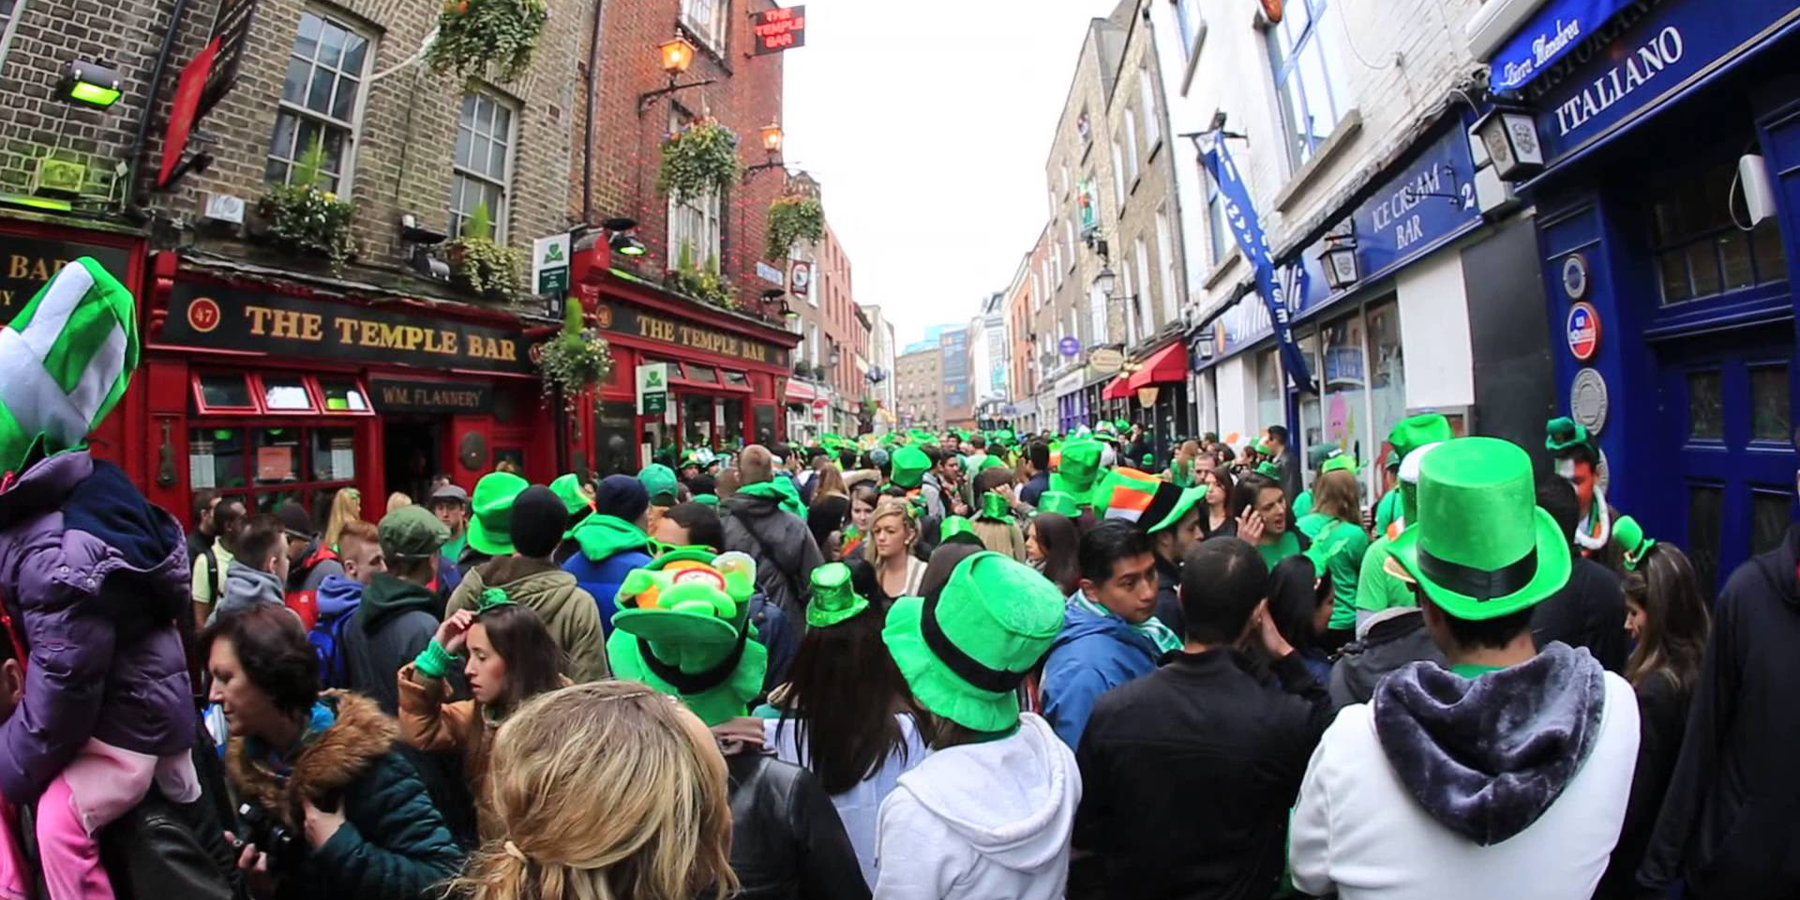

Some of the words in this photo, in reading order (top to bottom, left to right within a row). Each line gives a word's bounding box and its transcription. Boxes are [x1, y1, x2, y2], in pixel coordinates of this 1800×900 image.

[753, 17, 804, 36] TEMPLE
[765, 8, 792, 21] THE
[766, 33, 792, 47] BAR
[1554, 25, 1683, 137] ITALIANO
[1372, 201, 1391, 233] ICE
[1391, 162, 1440, 218] CREAM
[1461, 183, 1475, 211] 2
[1396, 214, 1423, 250] BAR
[195, 308, 213, 323] 47
[245, 306, 323, 341] THE
[335, 317, 458, 354] TEMPLE
[467, 335, 517, 361] BAR
[637, 315, 675, 342] THE
[679, 326, 737, 355] TEMPLE
[742, 342, 765, 362] BAR
[414, 389, 482, 408] FLANNERY
